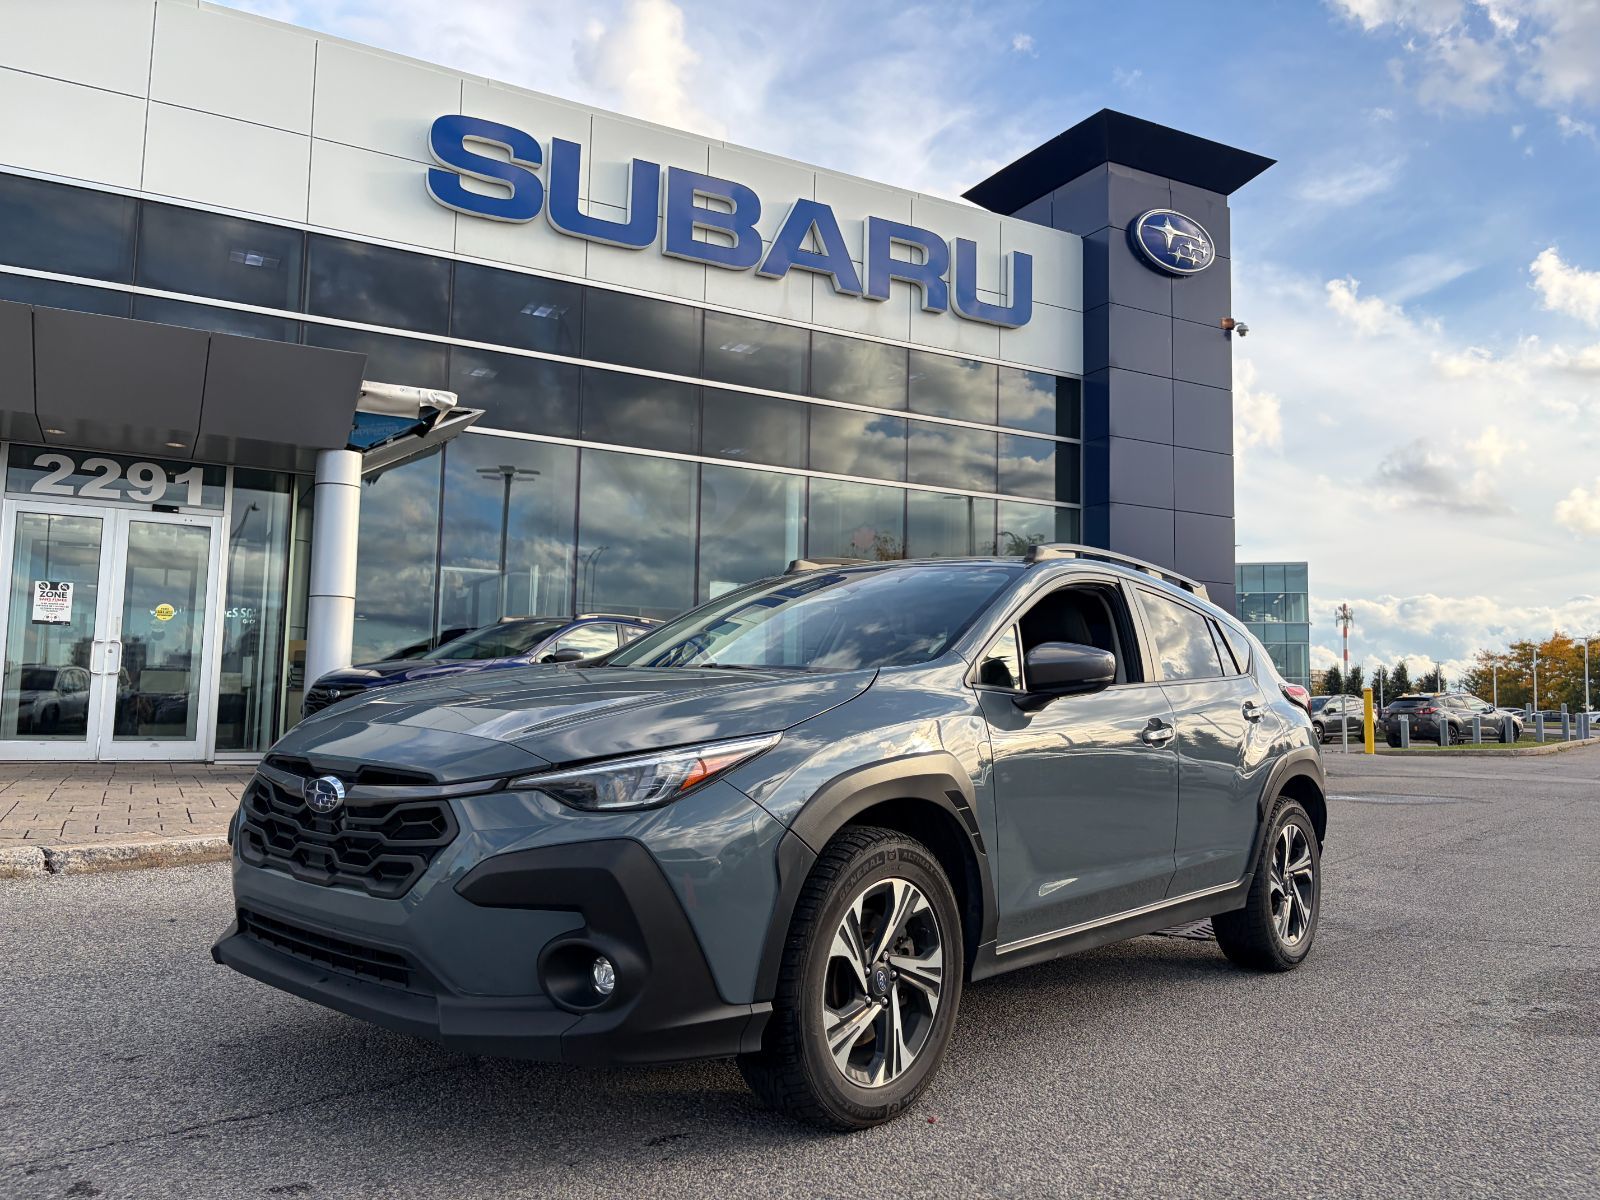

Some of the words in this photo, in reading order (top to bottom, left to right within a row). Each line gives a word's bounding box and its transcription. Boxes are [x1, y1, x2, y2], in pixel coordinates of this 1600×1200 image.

[425, 113, 1033, 329] SUBARU
[30, 453, 204, 506] 2291
[39, 590, 68, 599] ZONE
[839, 855, 884, 900] GENERAL
